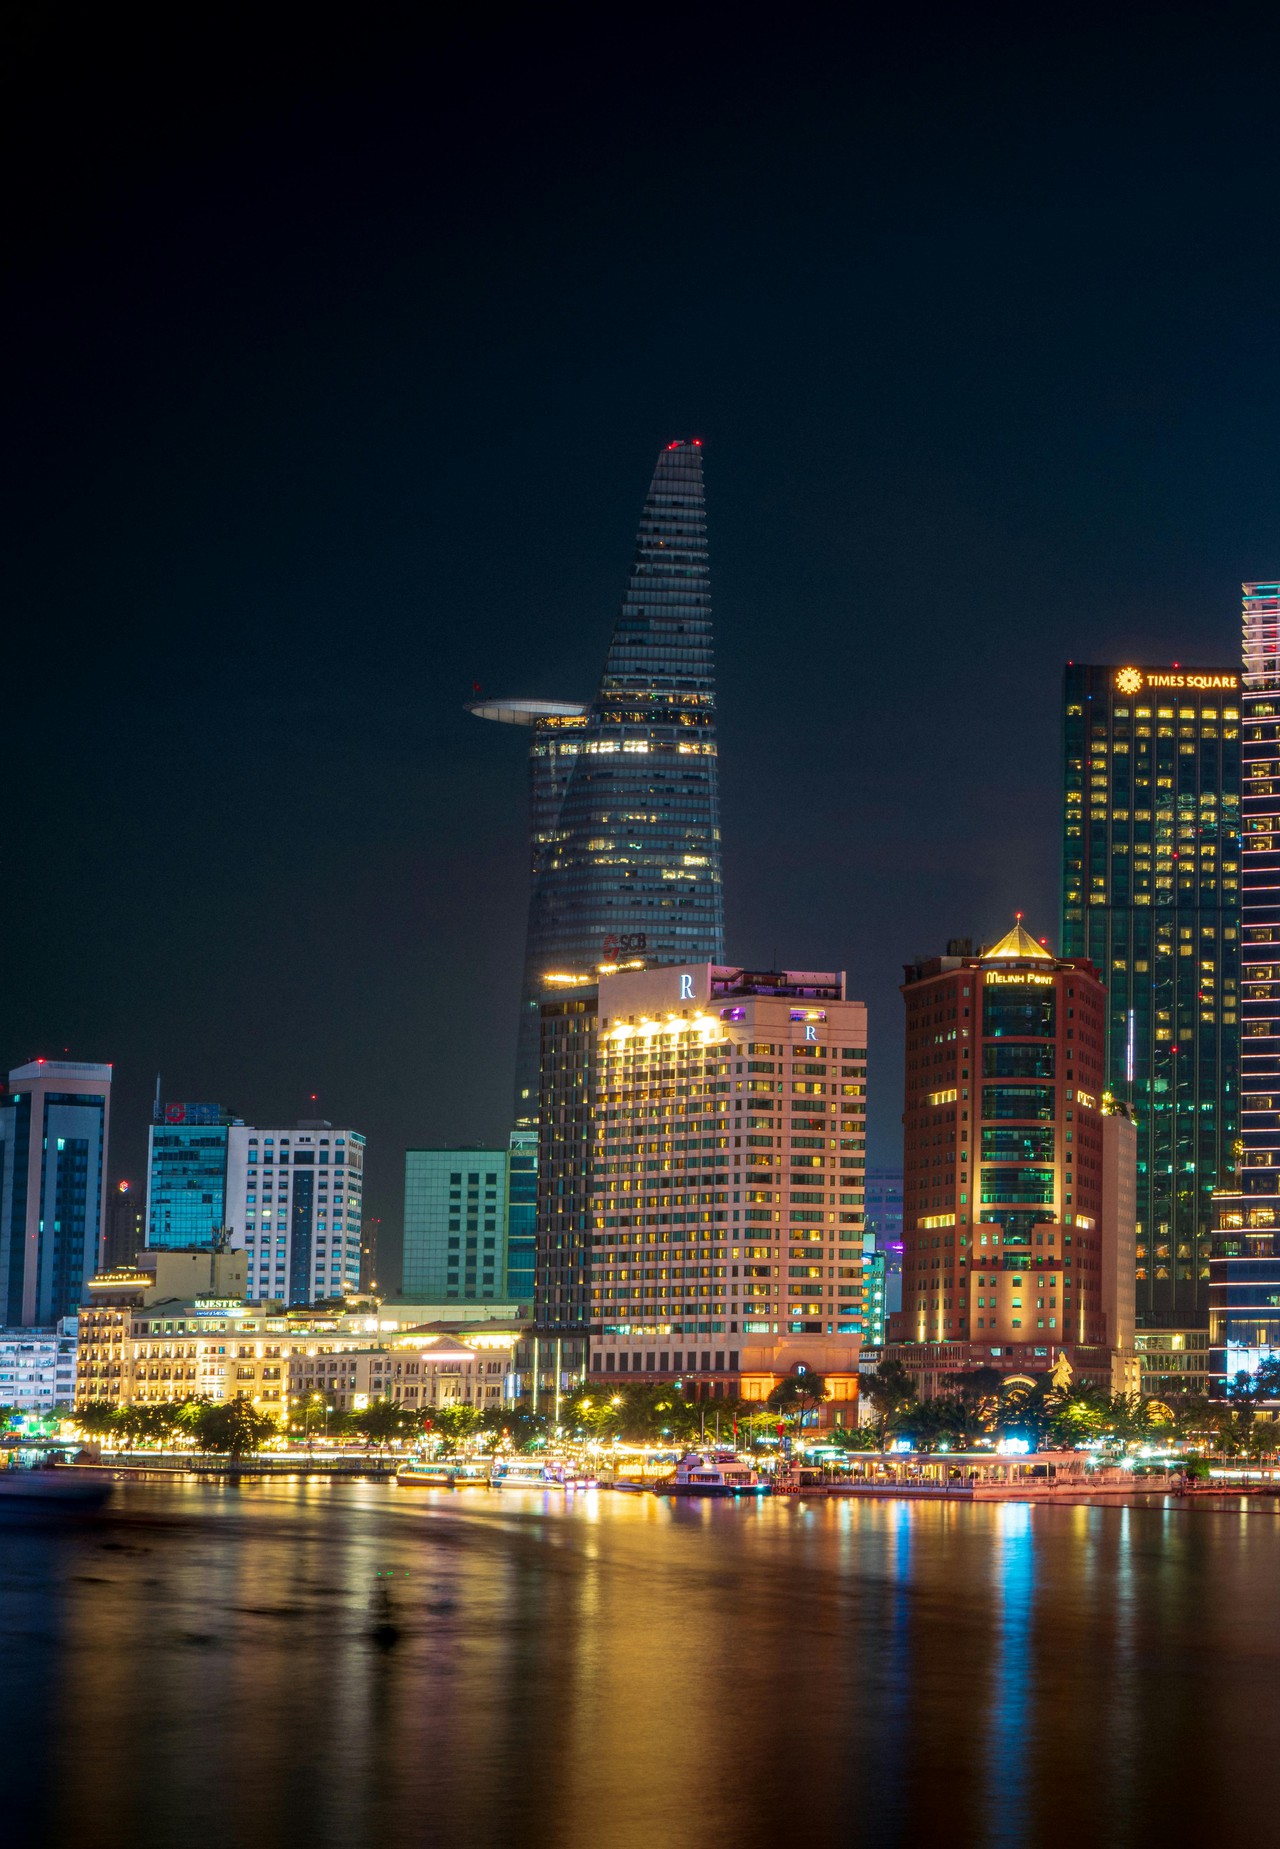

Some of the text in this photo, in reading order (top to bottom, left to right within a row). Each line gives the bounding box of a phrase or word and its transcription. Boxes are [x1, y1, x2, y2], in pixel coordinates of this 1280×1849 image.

[1147, 675, 1238, 689] TIMES SQUARE
[619, 932, 646, 951] SCB
[680, 974, 696, 1000] R
[805, 1025, 819, 1041] R
[194, 1300, 241, 1308] MAJESTIC
